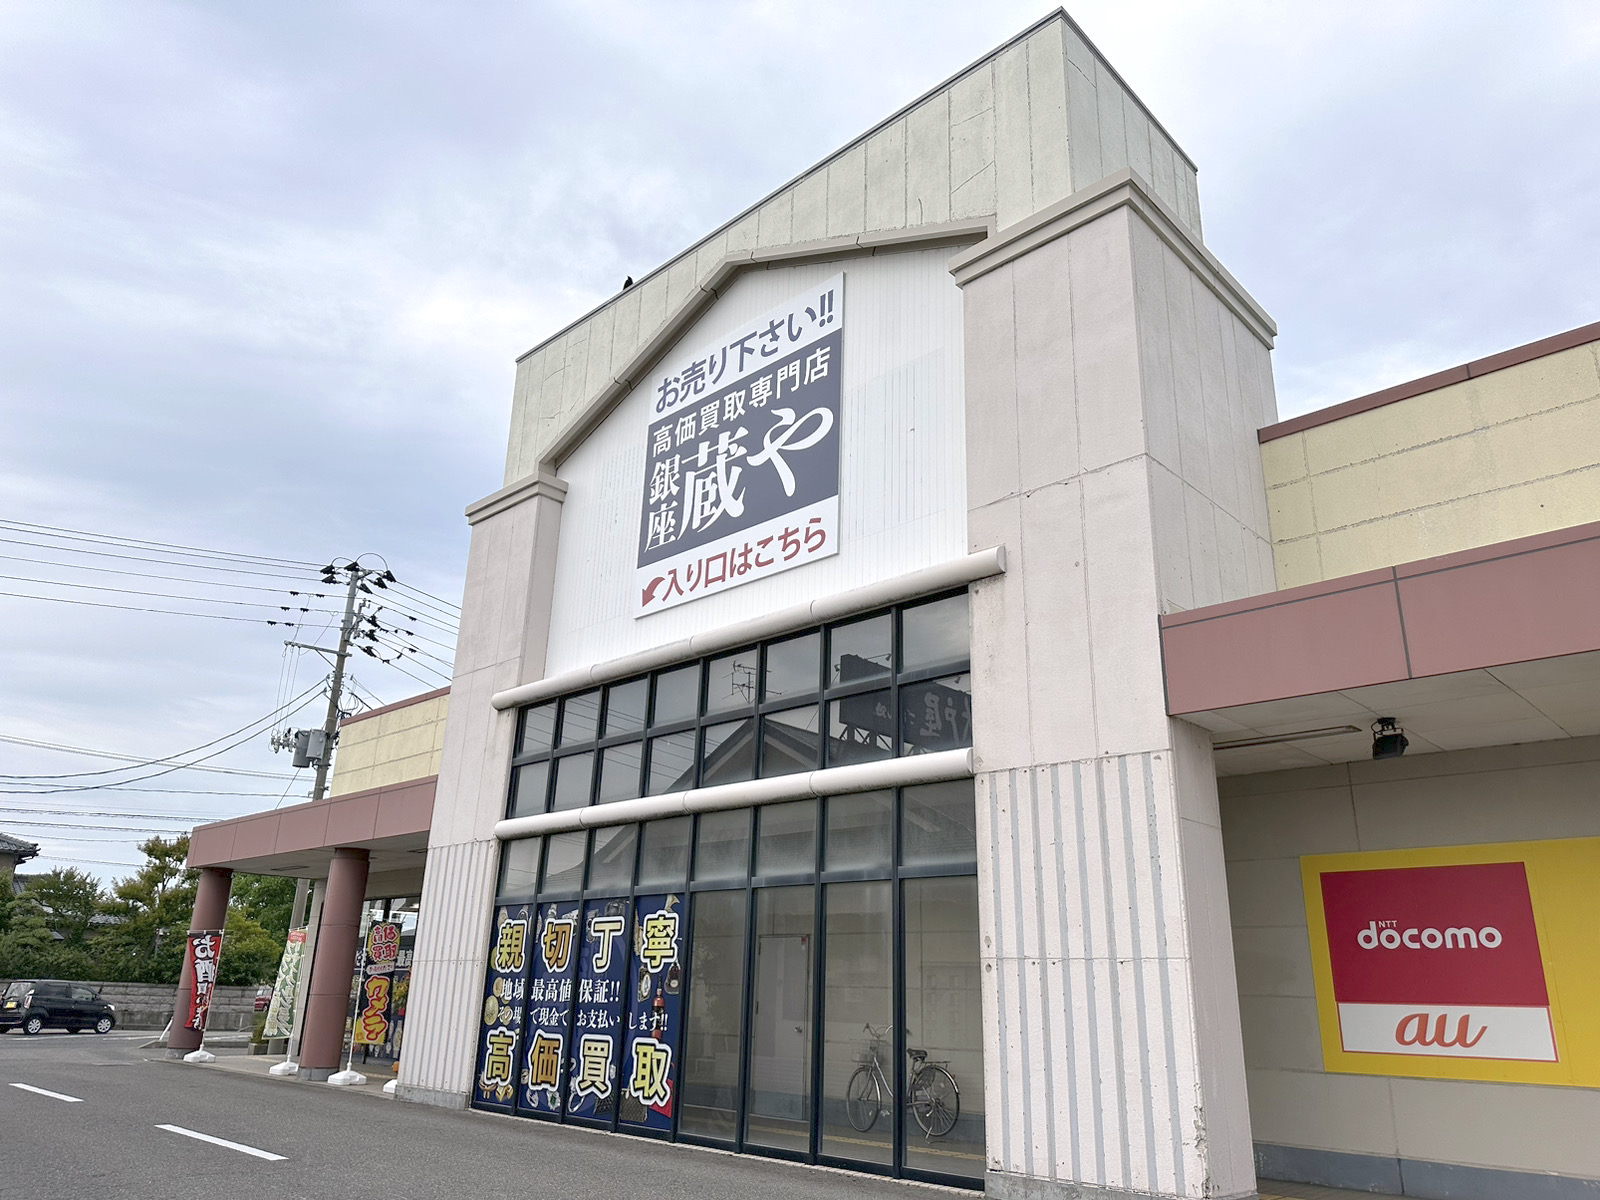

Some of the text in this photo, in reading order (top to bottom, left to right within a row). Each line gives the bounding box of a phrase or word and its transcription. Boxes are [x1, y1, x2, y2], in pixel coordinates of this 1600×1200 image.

[655, 289, 834, 414] お売り下さい!!
[652, 346, 831, 458] 高価買取専門店
[662, 518, 826, 600] 入り口はこちら
[1357, 921, 1502, 949] docomo
[1379, 920, 1397, 928] NTT
[363, 974, 389, 1042] カメラ
[1395, 1013, 1488, 1048] au
